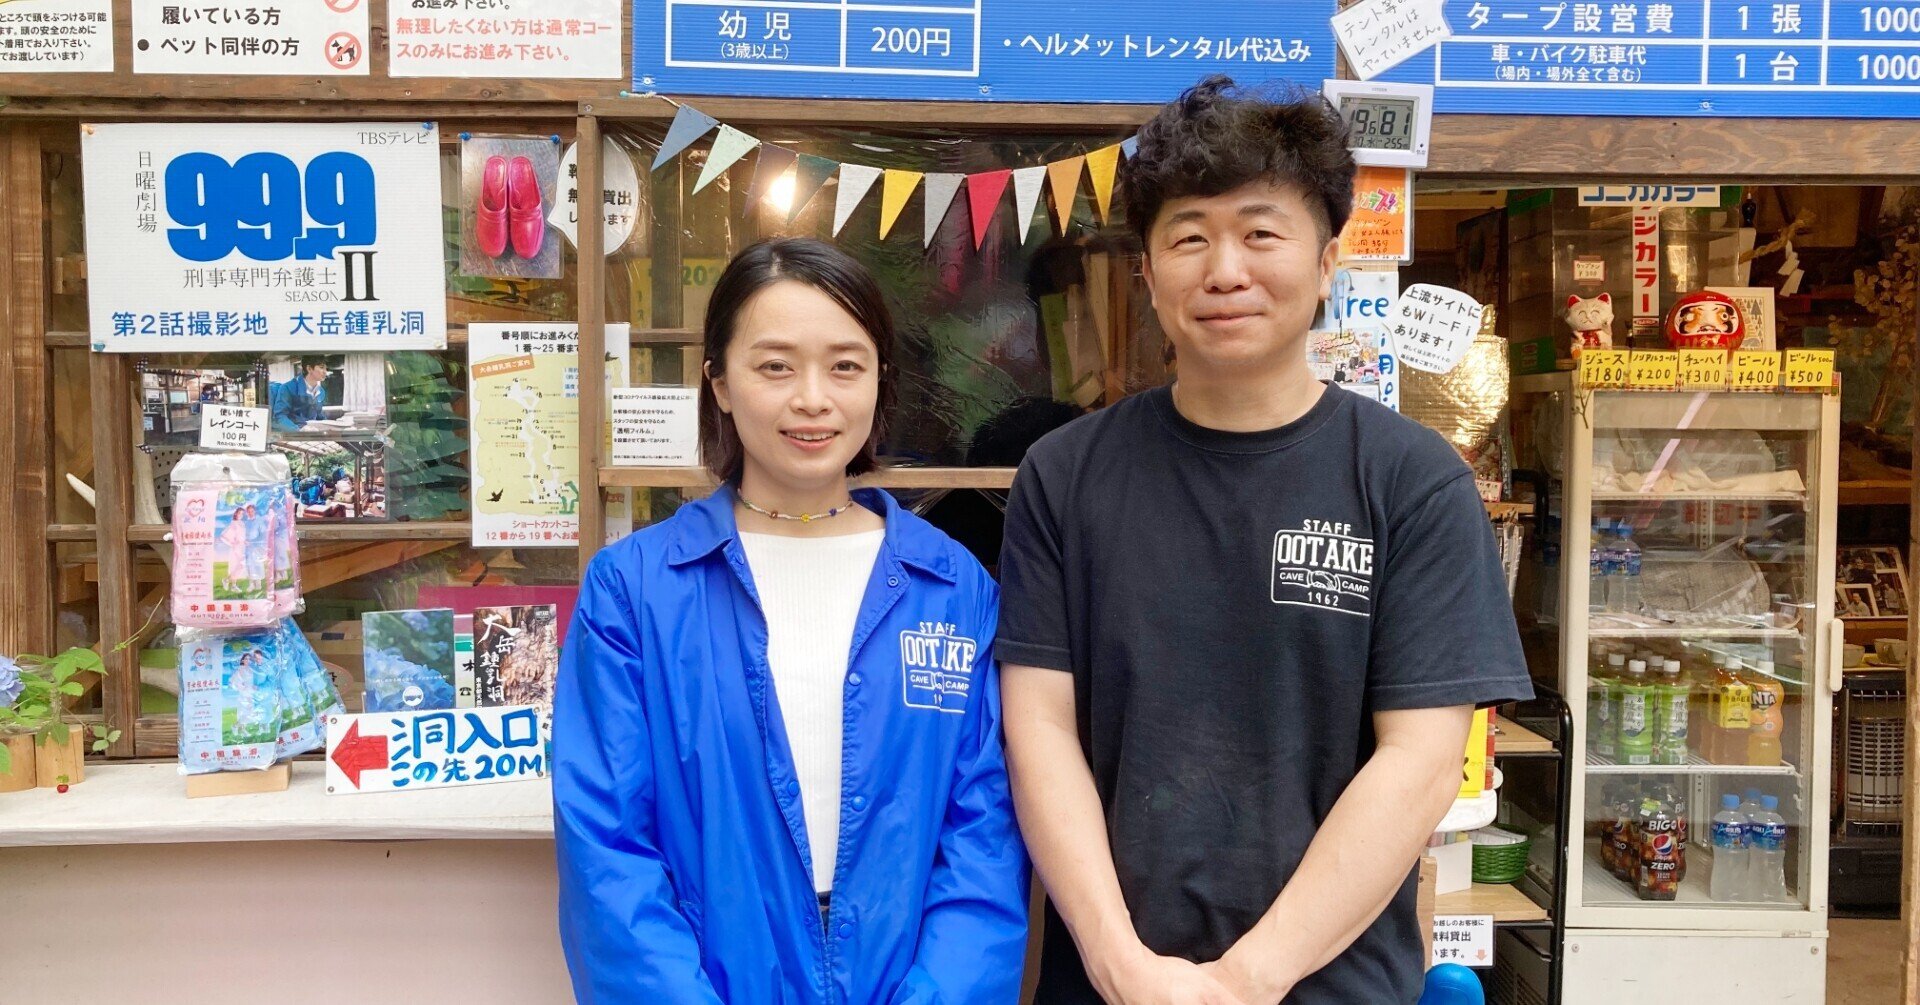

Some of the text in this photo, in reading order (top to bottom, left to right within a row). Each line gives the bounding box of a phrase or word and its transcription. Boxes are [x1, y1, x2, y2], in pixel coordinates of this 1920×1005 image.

[161, 6, 281, 26] 履いている方
[718, 10, 792, 41] 幼児
[1467, 1, 1675, 34] タープ設営費
[396, 17, 612, 36] 無理したくない方は通常コー
[161, 37, 300, 56] ペット同伴の方
[870, 26, 951, 57] 200円
[397, 43, 570, 61] スのみにお進み下さい。
[1491, 43, 1648, 66] 車・バイク駐車代
[1380, 110, 1411, 135] 81
[357, 131, 431, 146] TBSテレビ
[135, 150, 157, 234] 日曜劇場
[1634, 206, 1658, 313] ジカラー
[183, 267, 337, 289] 刑事専門弁護士
[285, 290, 339, 302] SEASON
[1406, 286, 1481, 319] 上流サイトに
[112, 311, 425, 336] 第2話撮影地 大岳鍾乳洞
[1586, 353, 1625, 365] ジュース
[1684, 353, 1724, 365] チューハイ
[1738, 355, 1776, 367] ビール
[1789, 353, 1817, 363] ビール
[220, 408, 252, 417] 使い捨て
[210, 419, 260, 431] レインコート
[512, 520, 579, 529] ショートカットコー
[1303, 518, 1352, 536] STAFF
[1277, 533, 1375, 576] OOTAKE
[1279, 571, 1370, 594] CAVE CAMP
[1307, 591, 1340, 607] 1962
[919, 621, 956, 636] STAFF
[910, 674, 970, 691] CAVE CAMP
[391, 708, 538, 760] 洞入口
[1650, 861, 1676, 871] ZERO
